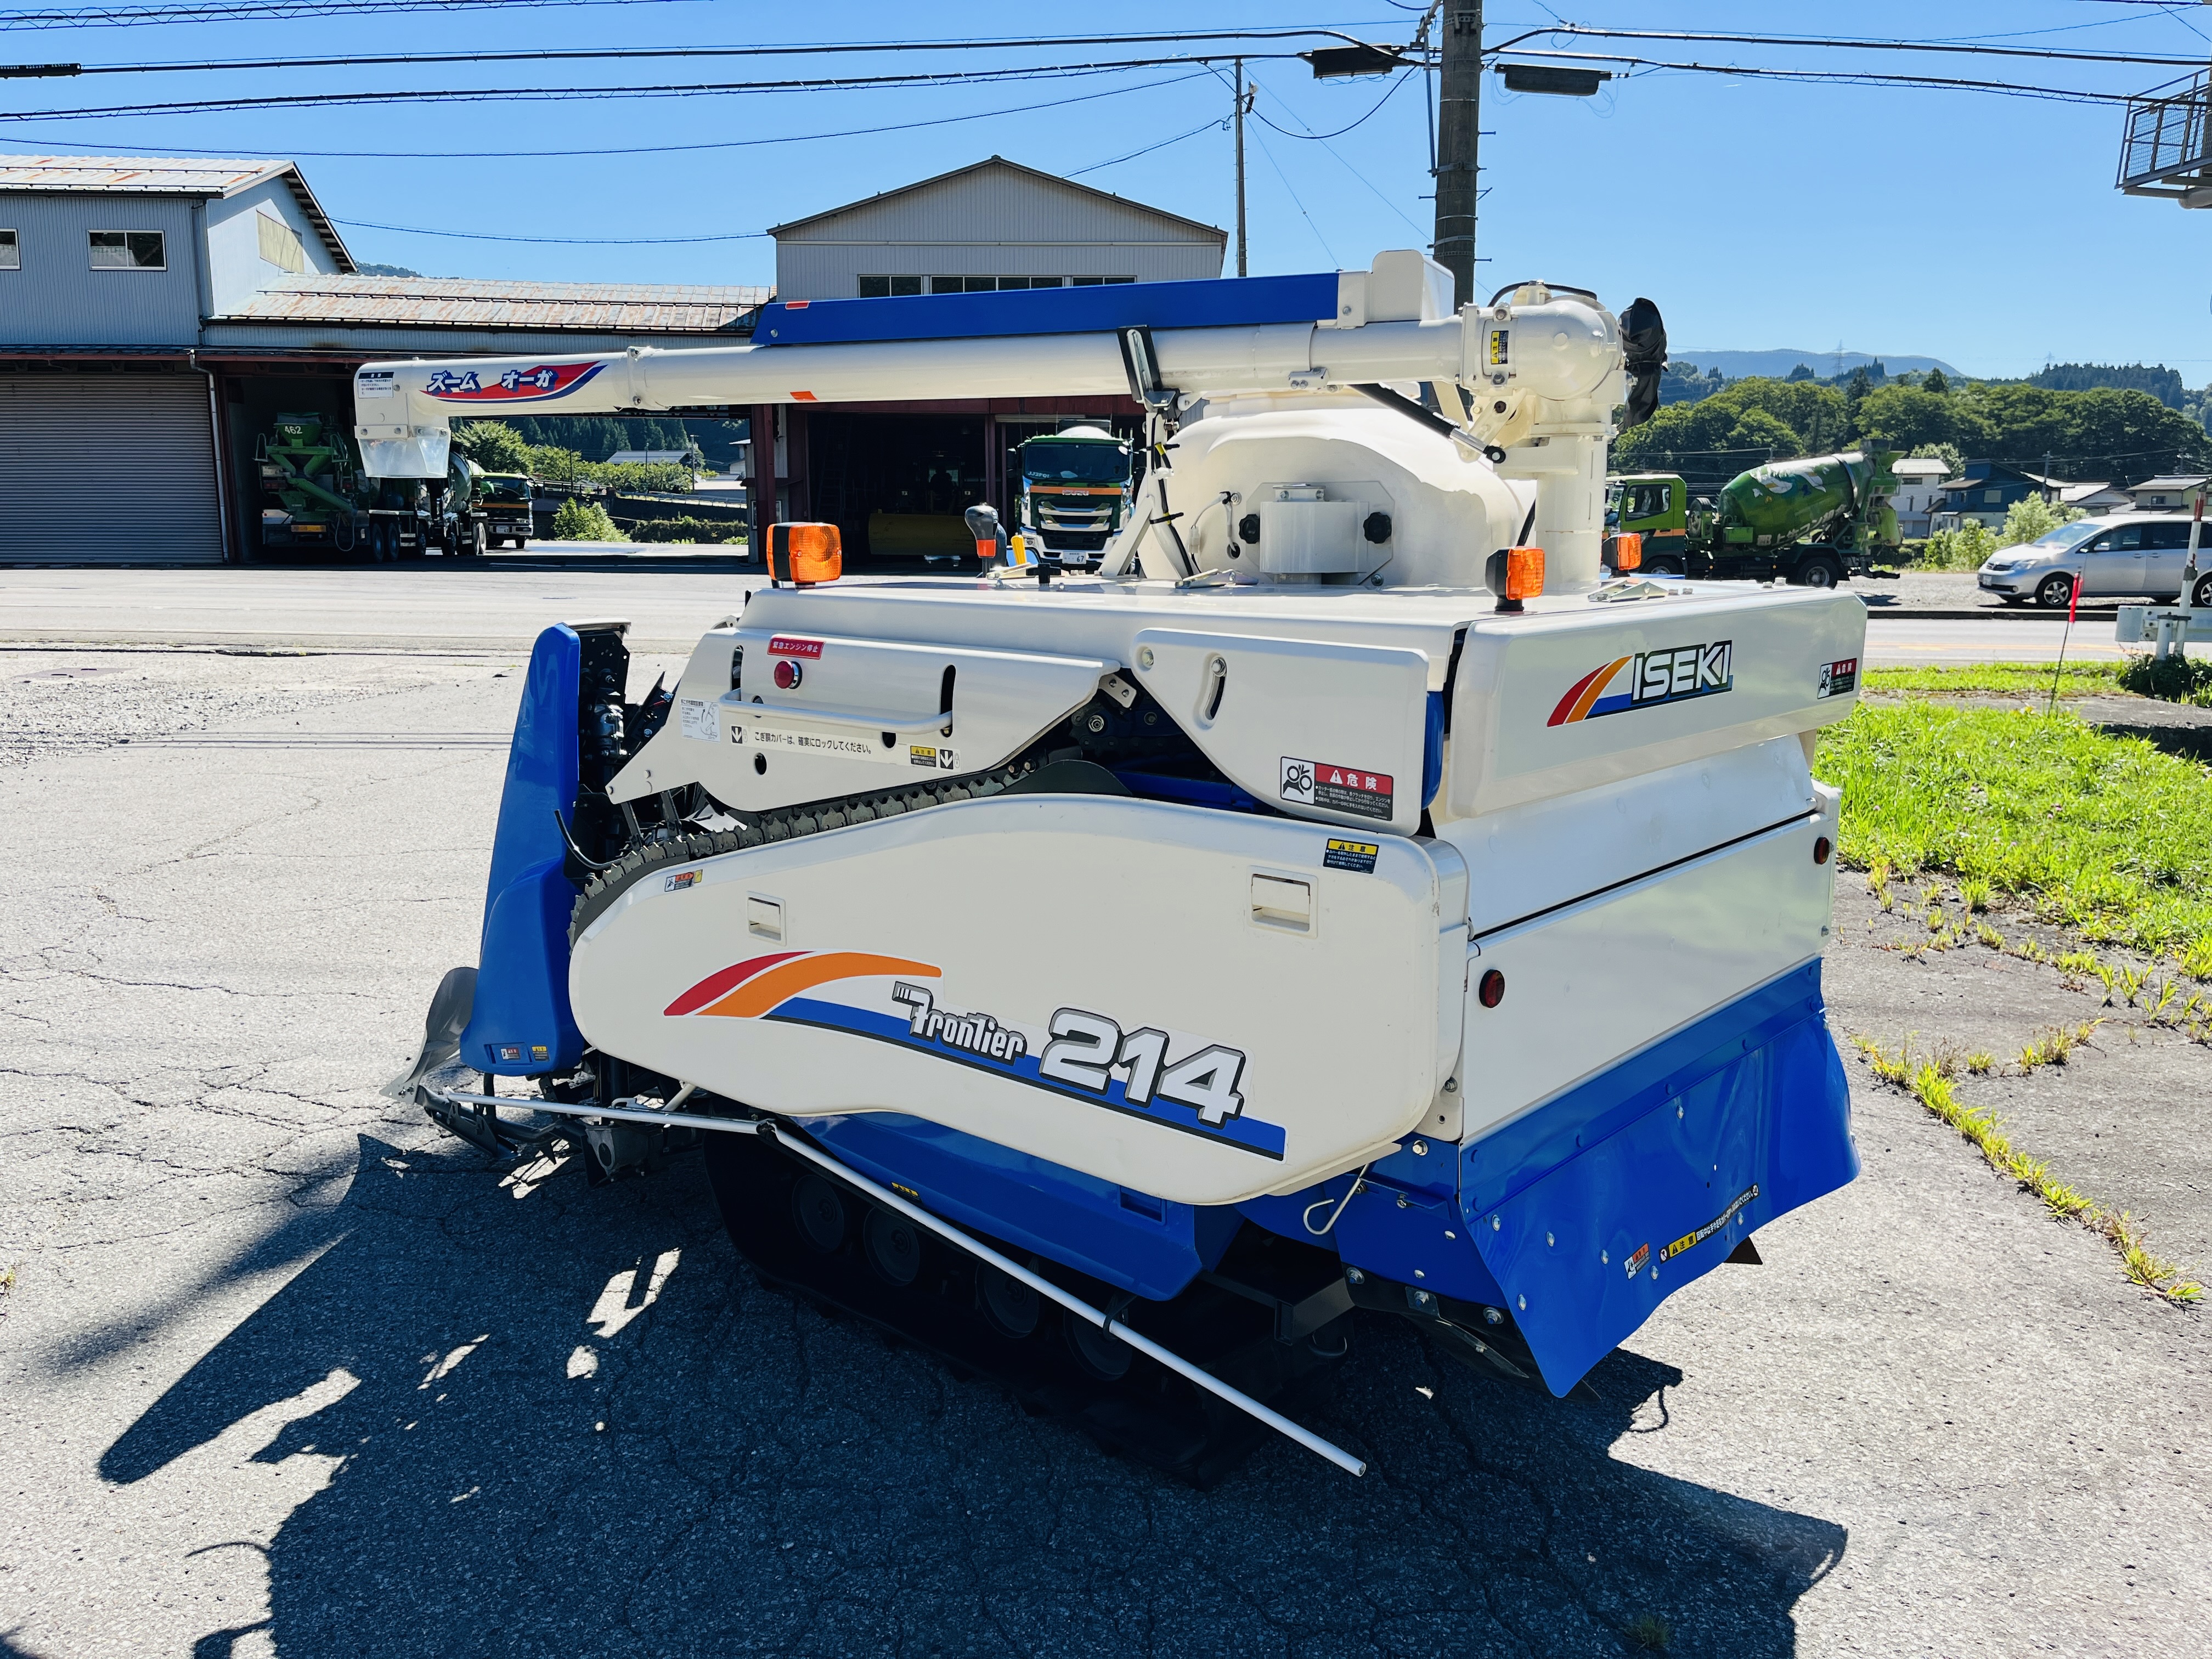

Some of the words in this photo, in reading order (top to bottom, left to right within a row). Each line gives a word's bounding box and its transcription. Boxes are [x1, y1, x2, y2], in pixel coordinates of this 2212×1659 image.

[427, 369, 481, 393] ズーム
[501, 369, 556, 390] オーガ
[285, 425, 303, 435] 462
[772, 641, 819, 654] 緊急エンジン停止
[1632, 642, 1731, 703] ISEKI
[1347, 773, 1377, 791] 危険
[1348, 844, 1365, 853] 注意
[892, 981, 1026, 1065] Frontier
[1040, 1007, 1245, 1128] 214
